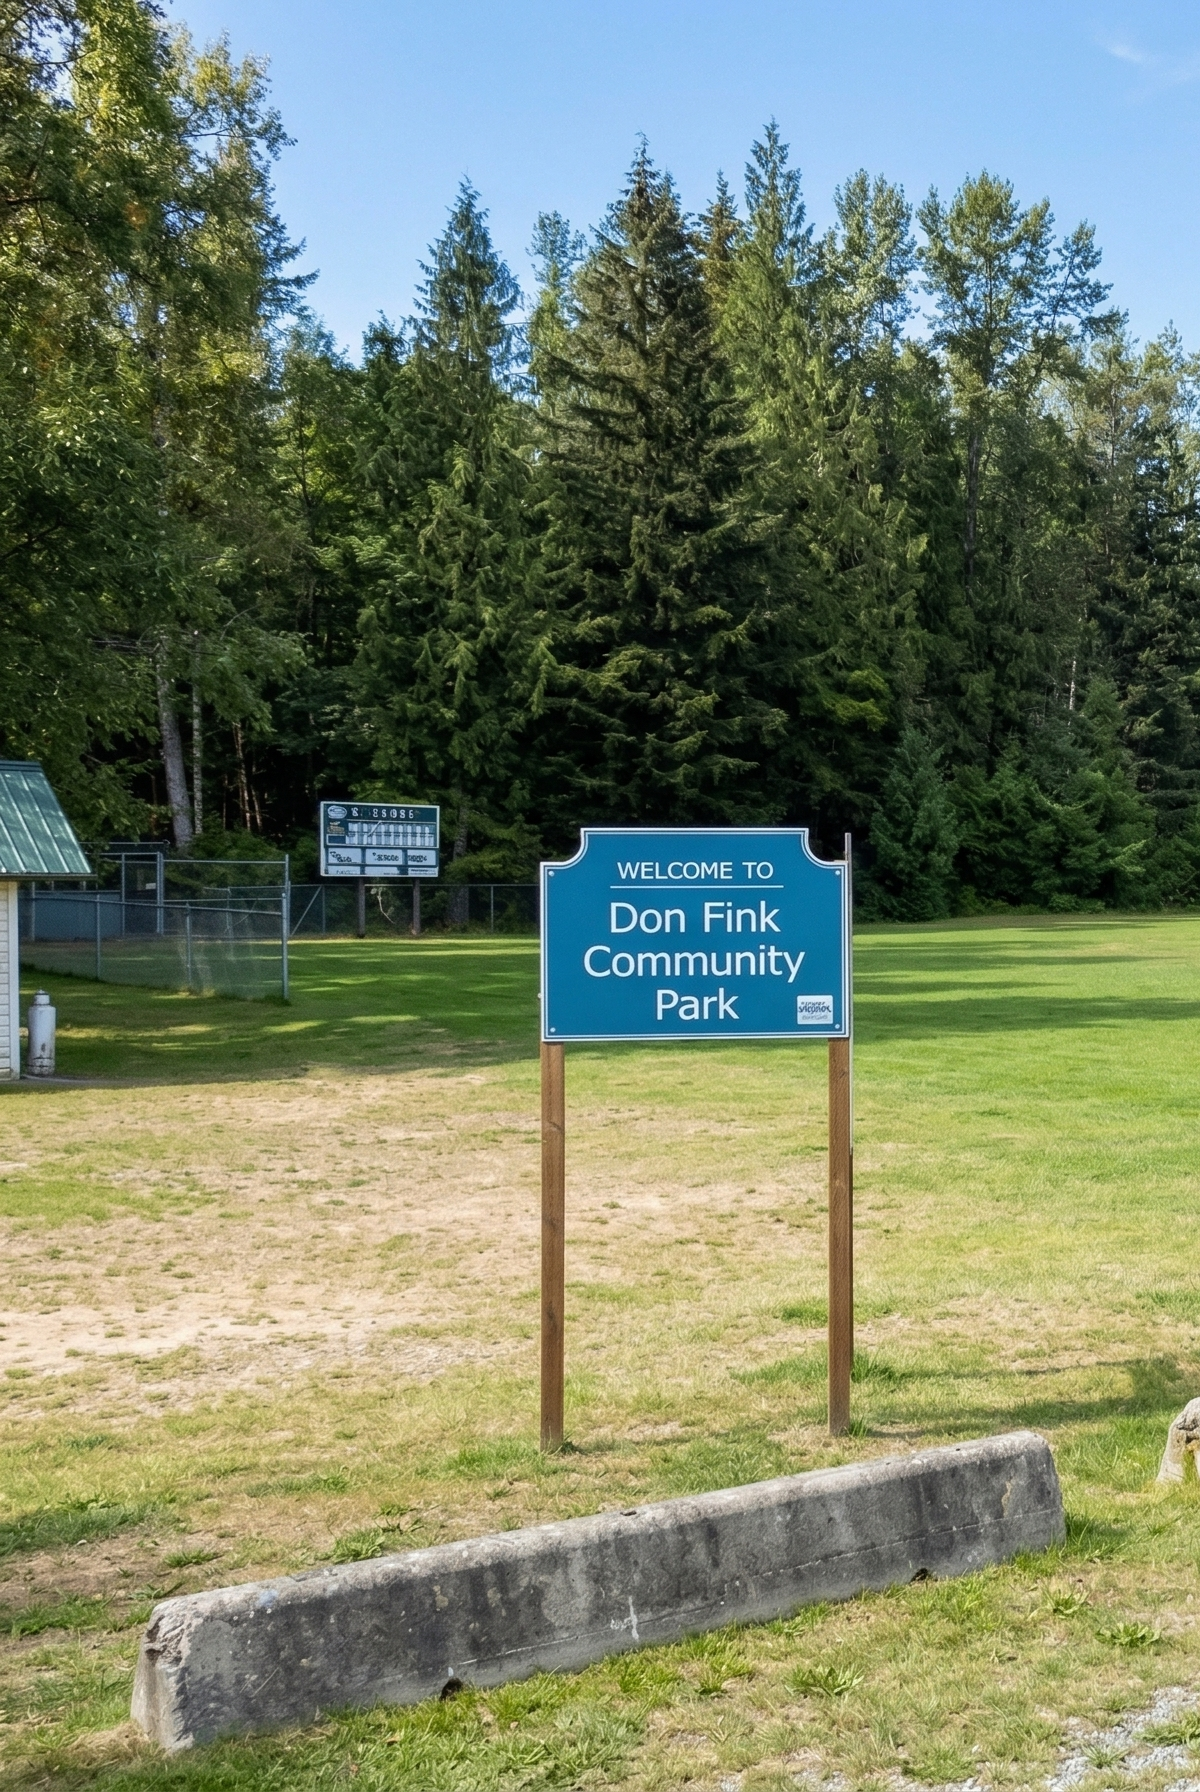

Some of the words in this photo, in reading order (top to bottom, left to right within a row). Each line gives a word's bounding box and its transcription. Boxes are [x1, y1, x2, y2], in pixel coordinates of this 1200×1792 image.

[617, 861, 733, 880] WELCOME
[742, 861, 774, 880] TO
[610, 902, 686, 934] Don
[704, 900, 781, 933] Fink
[583, 944, 806, 983] Community
[656, 987, 740, 1021] Park
